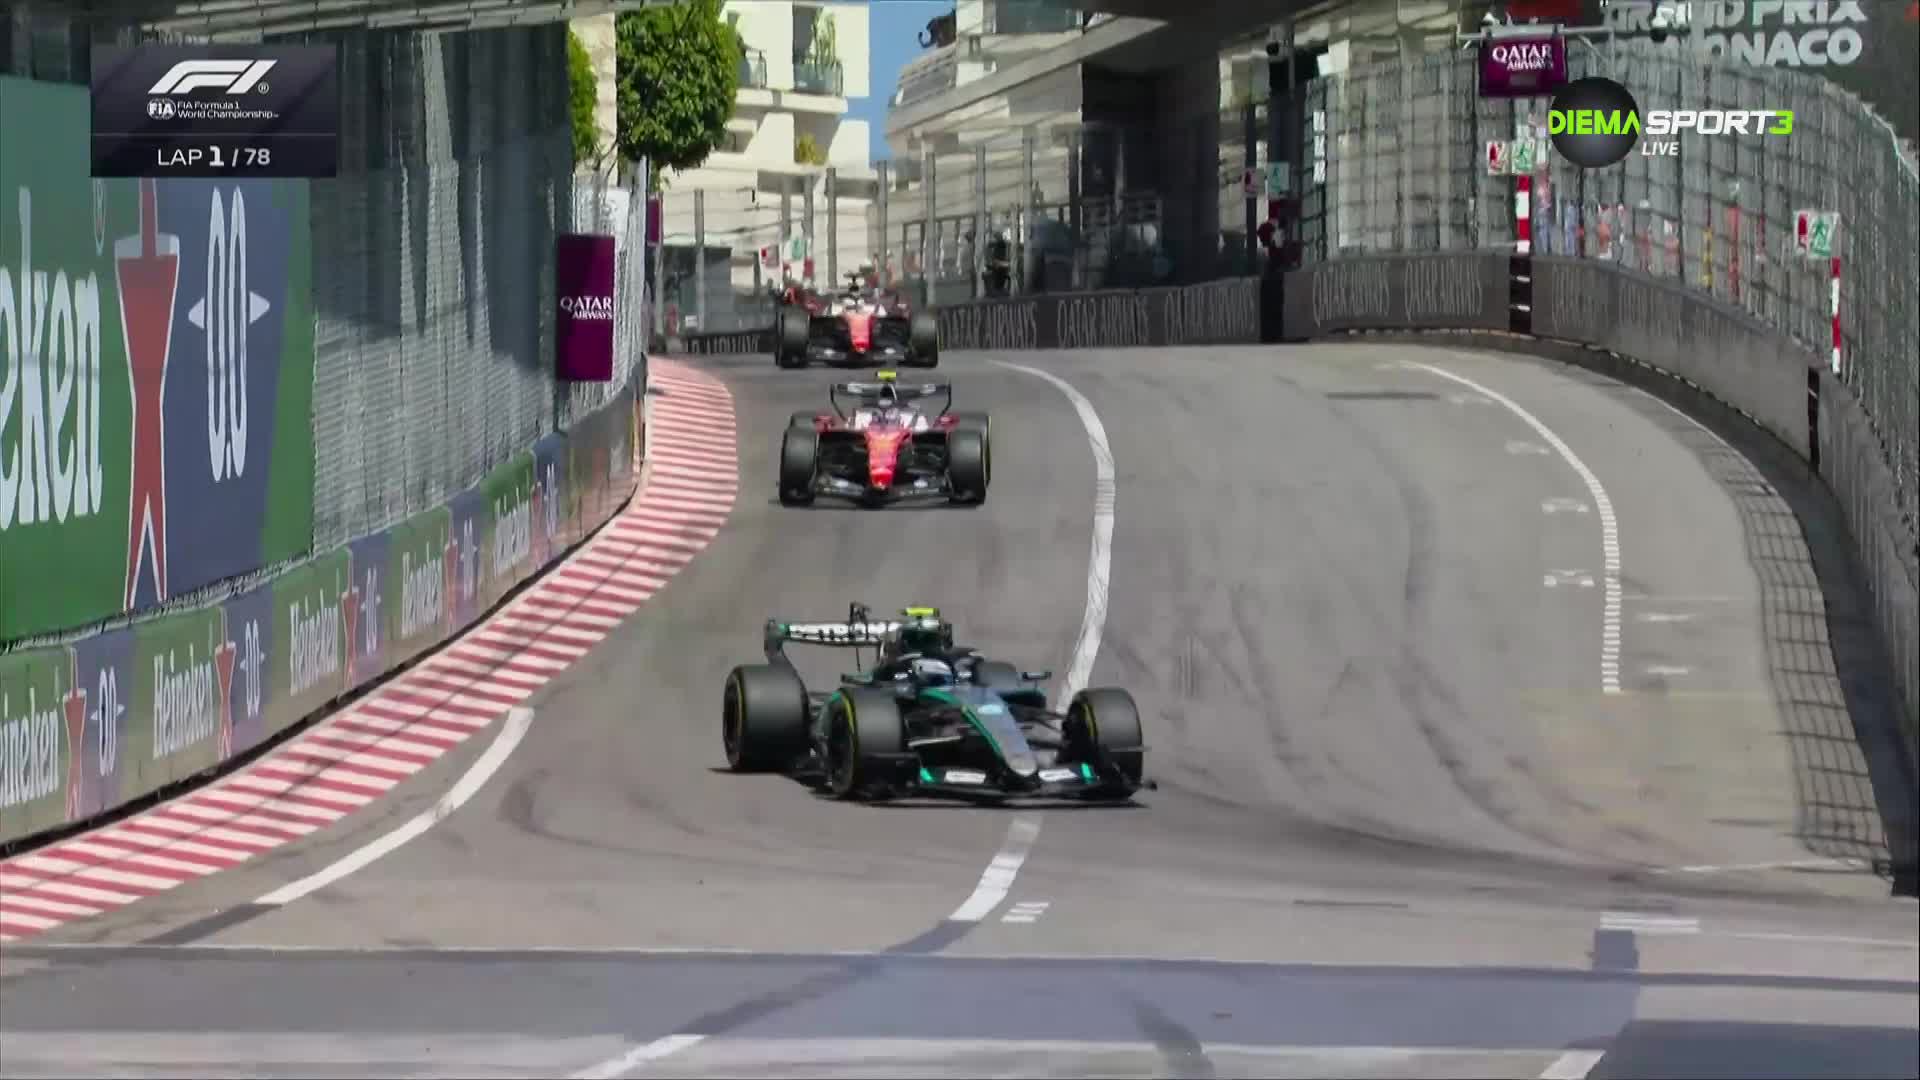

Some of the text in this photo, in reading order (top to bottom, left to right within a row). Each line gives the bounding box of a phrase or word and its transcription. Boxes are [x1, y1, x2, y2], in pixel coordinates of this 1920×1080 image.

[1603, 0, 1868, 31] GRND PRIX
[1492, 44, 1552, 63] QATAR
[560, 296, 612, 311] QATAR
[572, 309, 612, 320] AIRWAYS
[289, 588, 339, 697] Heineken
[153, 643, 214, 760] Heineken
[0, 687, 60, 808] ineken
